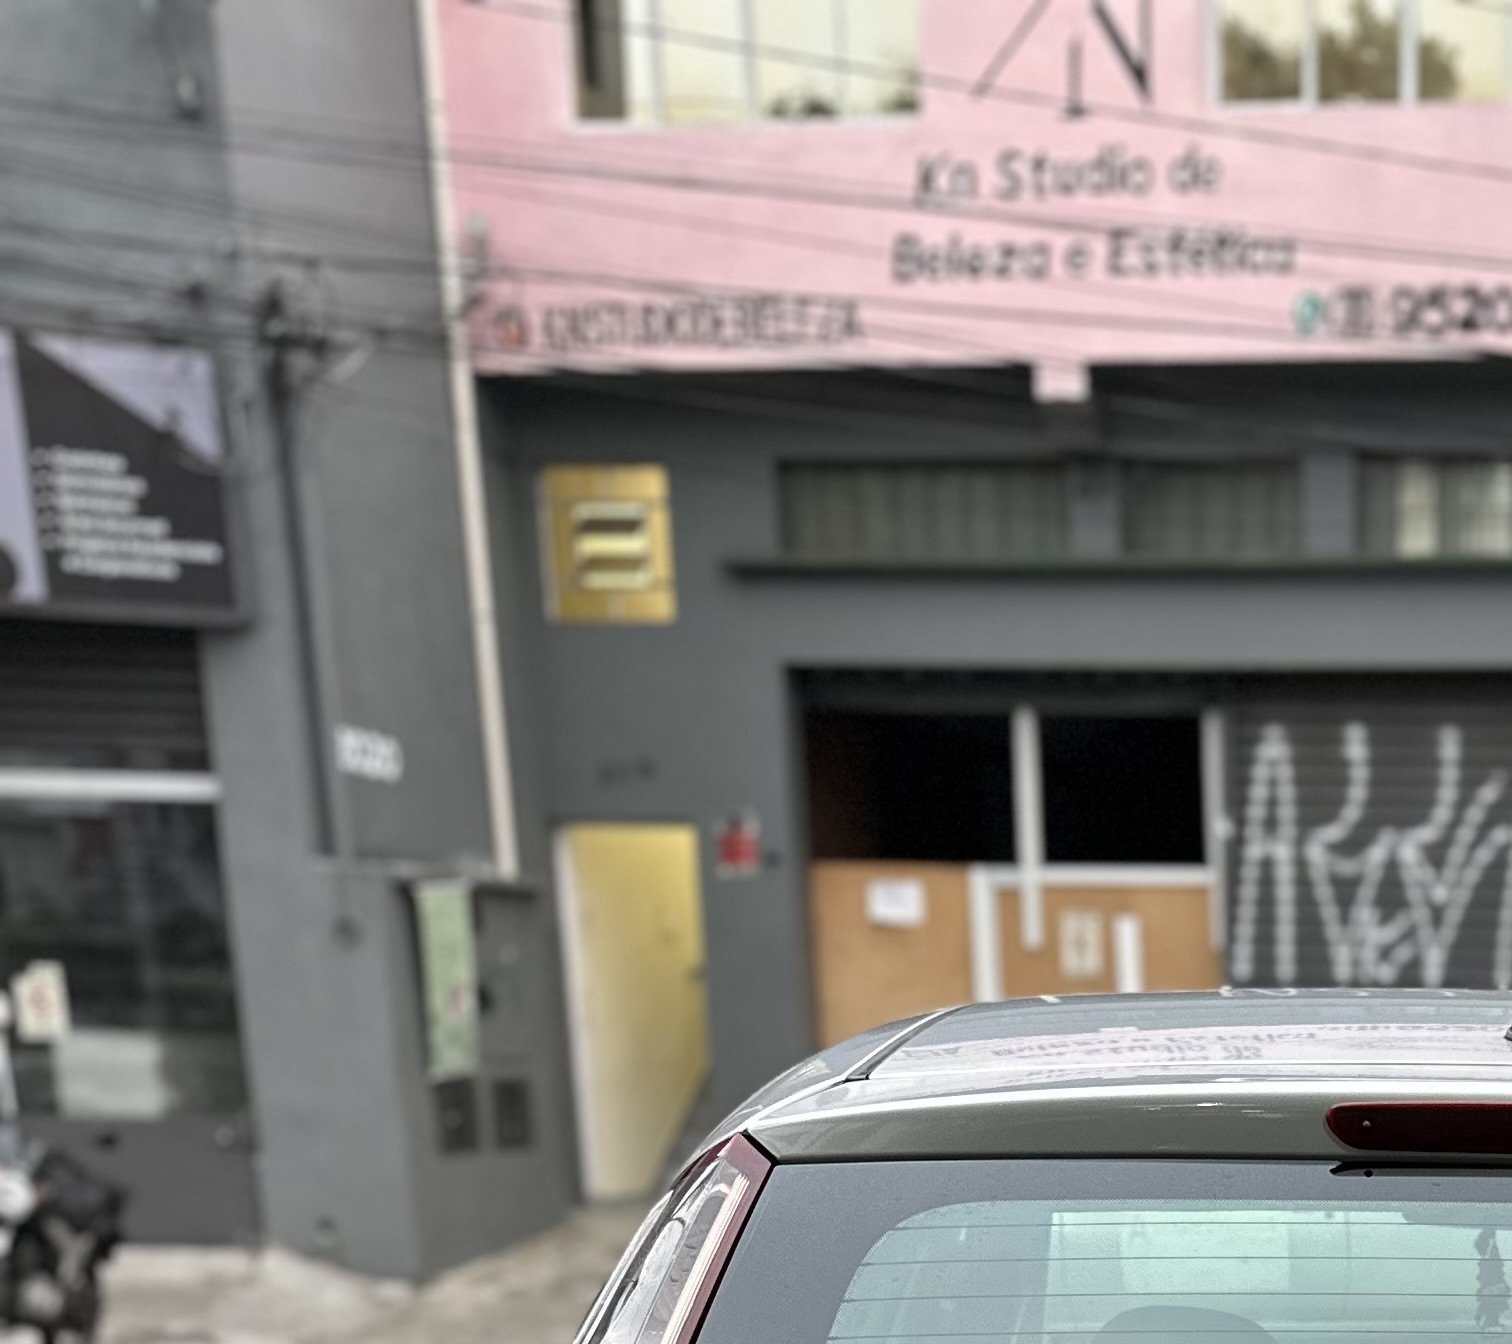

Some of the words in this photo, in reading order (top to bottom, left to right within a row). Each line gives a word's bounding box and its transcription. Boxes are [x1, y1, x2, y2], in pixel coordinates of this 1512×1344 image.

[996, 146, 1154, 200] Studio
[1166, 142, 1222, 192] de
[890, 230, 1052, 286] Beleza
[1064, 240, 1094, 280] e
